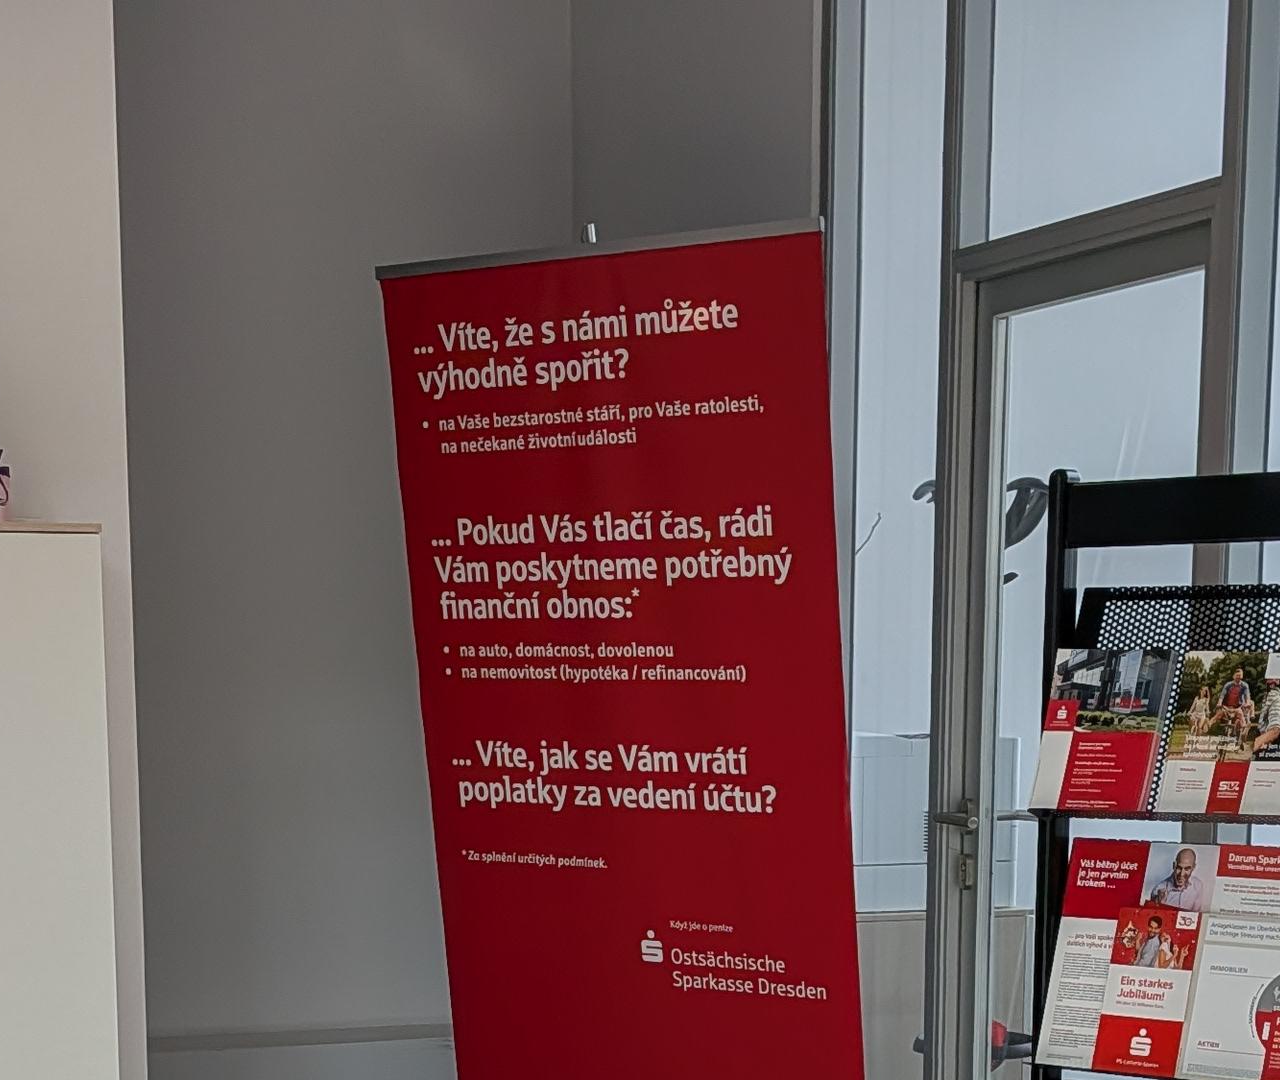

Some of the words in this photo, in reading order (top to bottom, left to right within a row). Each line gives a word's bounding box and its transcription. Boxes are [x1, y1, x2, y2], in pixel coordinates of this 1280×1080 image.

[438, 322, 499, 354] Víte,
[505, 318, 533, 346] že
[541, 324, 556, 343] s
[562, 306, 627, 341] námi
[634, 298, 738, 336] můžete
[417, 356, 527, 399] výhodně
[535, 349, 629, 390] spořit?
[439, 416, 457, 431] na
[458, 412, 490, 430] Vaše
[493, 405, 583, 428] bezstarostné
[586, 404, 625, 422] stáří,
[628, 405, 652, 421] pro
[655, 399, 691, 418] Vaše
[694, 394, 764, 414] ratolesti,
[441, 440, 458, 453] na
[460, 433, 525, 452] nečekané
[458, 514, 535, 546] Pokud
[540, 513, 587, 543] Vás
[593, 510, 653, 542] tlačí
[659, 509, 712, 543] čas,
[719, 505, 774, 538] rádi
[434, 551, 489, 584] Vám
[496, 553, 658, 590] poskytneme
[665, 547, 793, 585] potřebný
[440, 590, 540, 620] finanční
[459, 645, 476, 657] na
[478, 644, 513, 660] auto,
[515, 642, 595, 660] domácnost,
[597, 642, 674, 658] dovolenou
[461, 667, 478, 679] na
[480, 665, 557, 680] nemovitost
[560, 664, 629, 683] (hypotéka
[641, 665, 747, 683] refinancování)
[476, 740, 535, 773] Víte,
[540, 740, 579, 776] jak
[584, 748, 613, 771] se
[617, 743, 679, 773] Vám
[684, 746, 748, 775] vrátí
[459, 777, 567, 813] poplatky
[574, 785, 602, 806] za
[606, 780, 697, 810] vedení
[702, 784, 778, 813] účtu?
[482, 851, 516, 864] splnění
[518, 853, 556, 867] určitých
[558, 855, 608, 869] podmínek.
[1080, 859, 1095, 868] Váš
[1096, 860, 1119, 871] běžný
[1121, 862, 1138, 871] účet
[1228, 853, 1257, 863] Darum
[1077, 877, 1106, 888] krokem
[1078, 868, 1086, 878] je
[1087, 869, 1100, 879] jen
[1102, 871, 1129, 880] prvním
[671, 948, 785, 973] Ostsächsische
[672, 970, 753, 993] Sparkasse
[758, 978, 827, 1000] Dresden
[1120, 976, 1135, 986] Ein
[1138, 979, 1174, 989] starkes
[1117, 988, 1165, 1001] Jubiläum!
